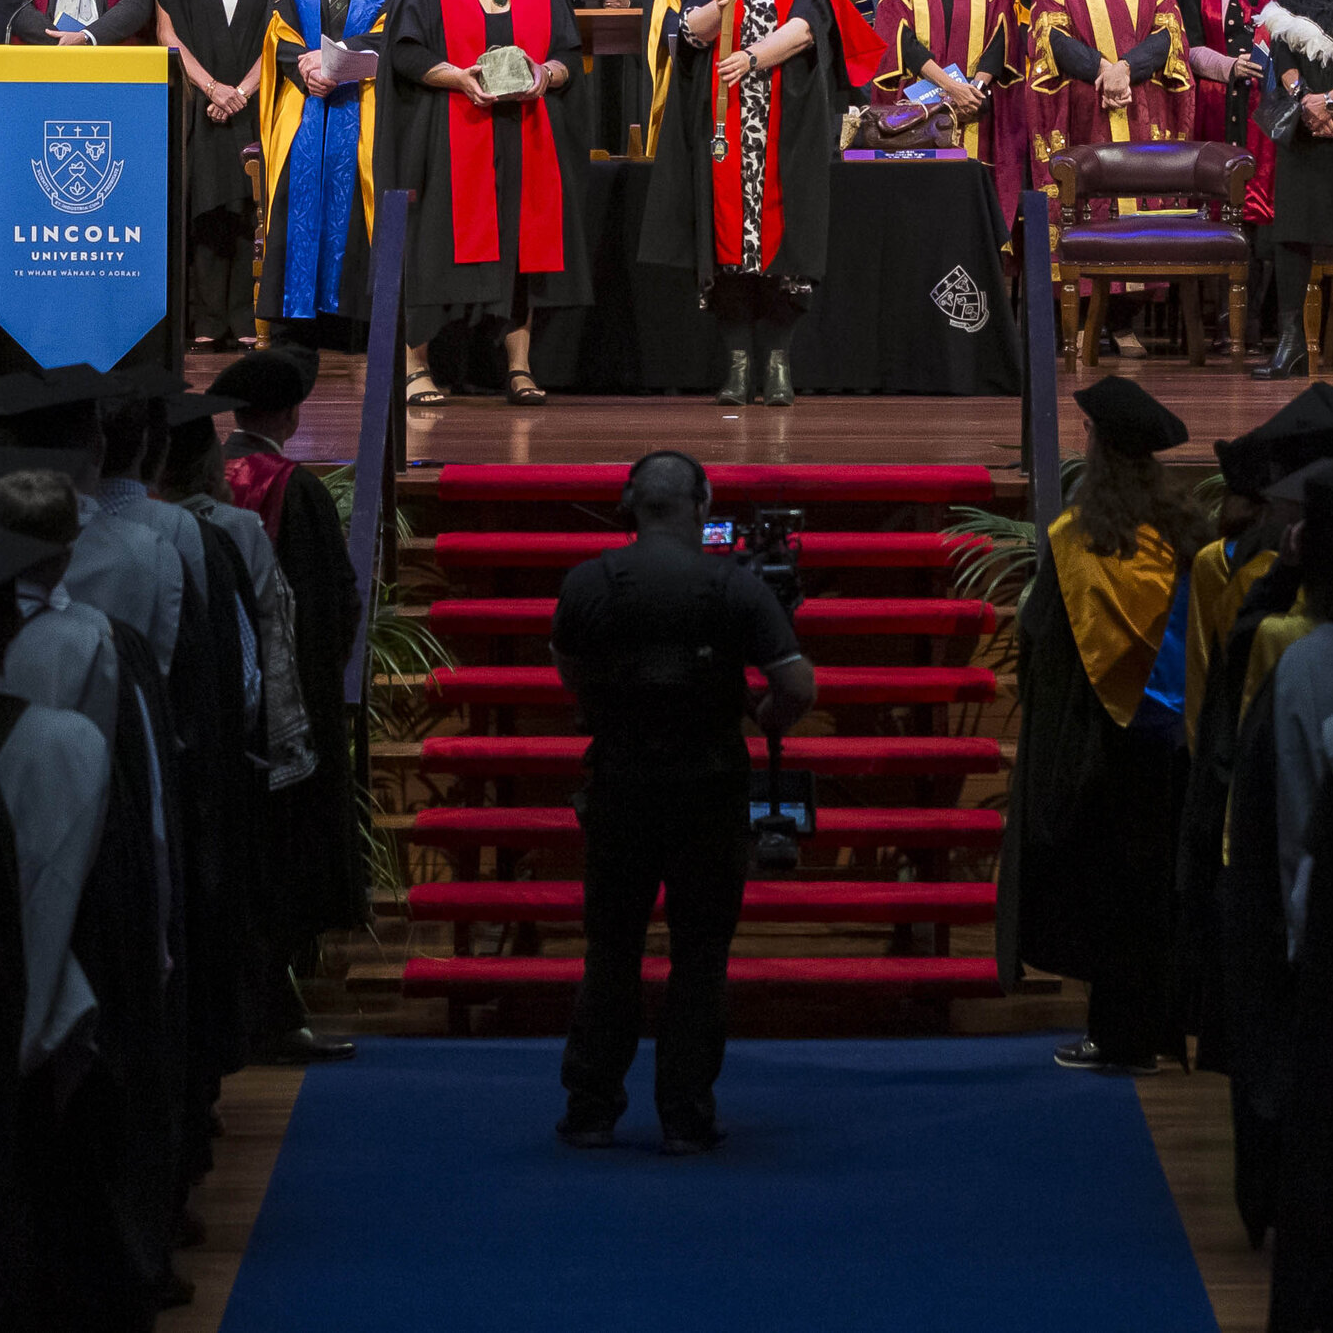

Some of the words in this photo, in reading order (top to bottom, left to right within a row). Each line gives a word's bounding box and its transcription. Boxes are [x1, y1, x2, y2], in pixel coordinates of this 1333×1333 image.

[14, 225, 141, 243] LINCOLN
[31, 251, 124, 261] UNIVERSITY
[28, 269, 57, 277] WHARE
[108, 269, 140, 277] AORAKI
